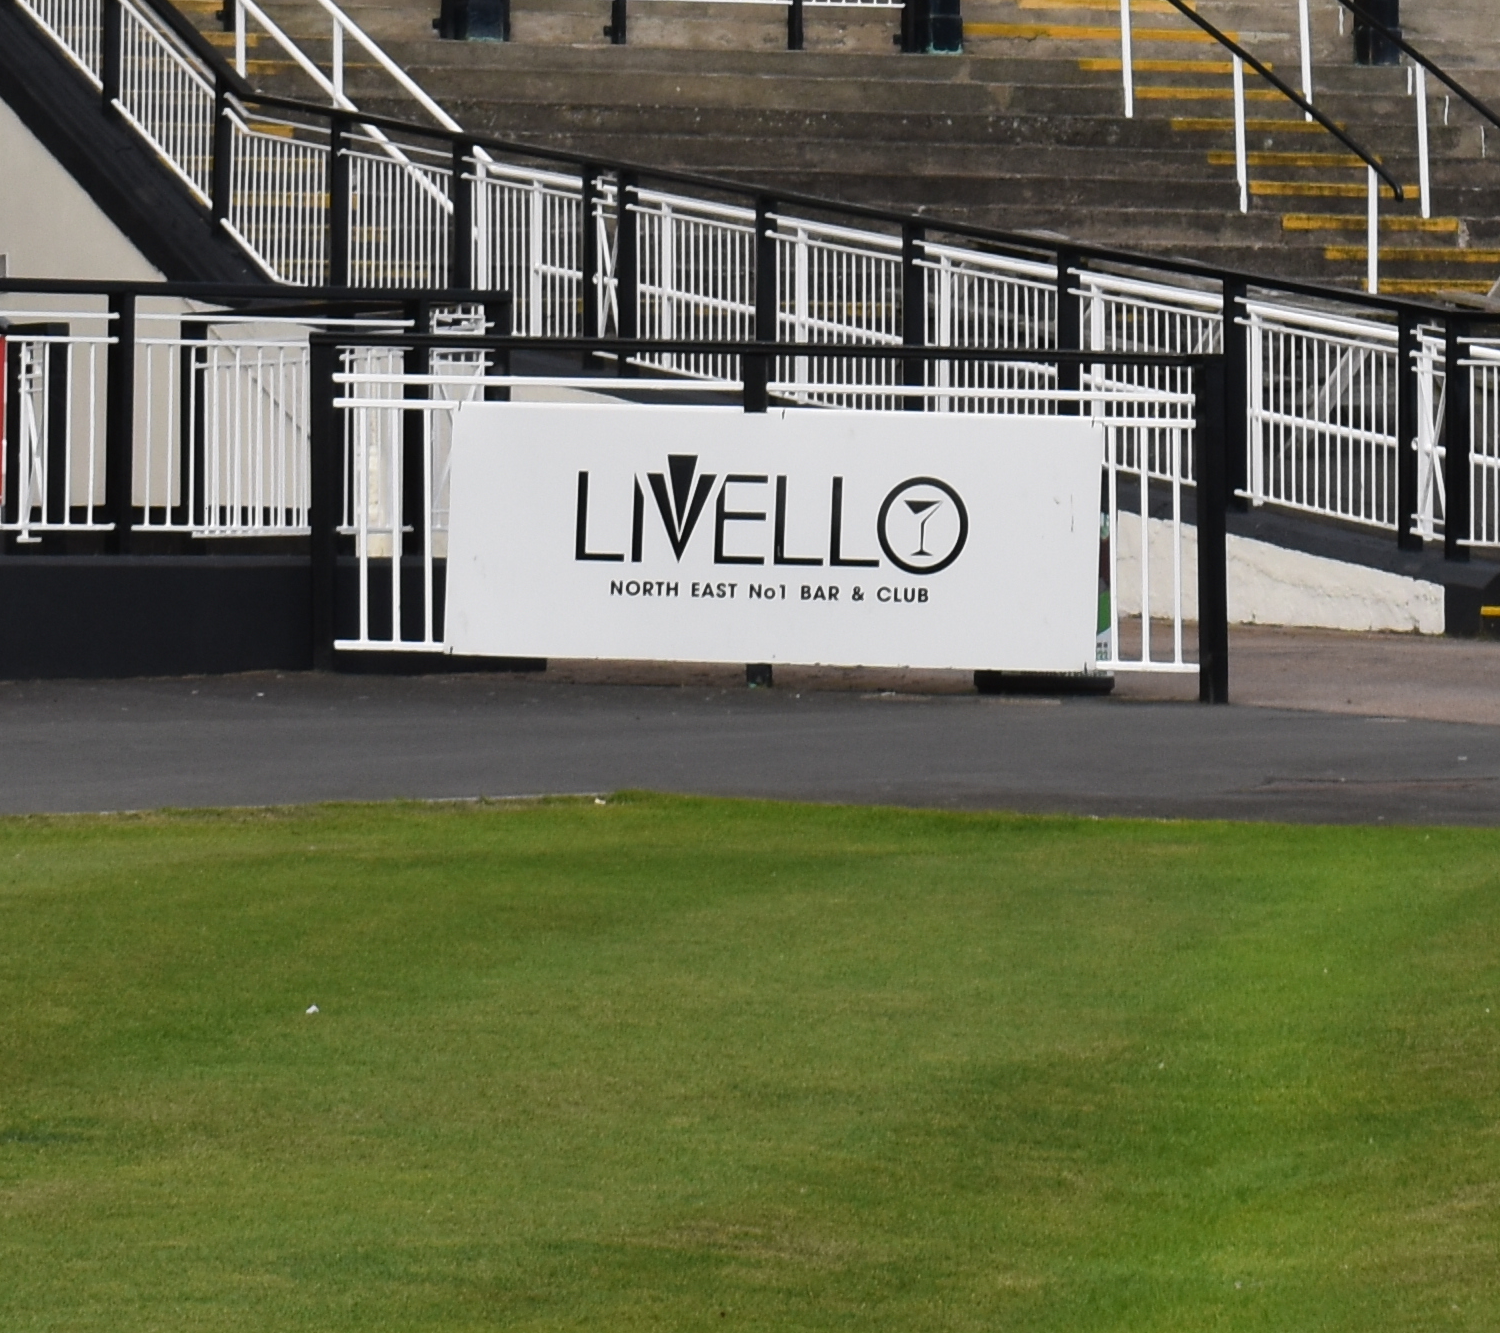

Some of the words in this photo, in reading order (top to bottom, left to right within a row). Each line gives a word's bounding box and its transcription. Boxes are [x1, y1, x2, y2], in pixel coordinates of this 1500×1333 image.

[574, 454, 969, 575] LIVELLO
[610, 579, 680, 598] NORTH
[690, 581, 739, 599] EAST
[748, 583, 787, 600] No1
[799, 585, 840, 602] BAR
[851, 587, 866, 602] &
[876, 586, 930, 604] CLUB
